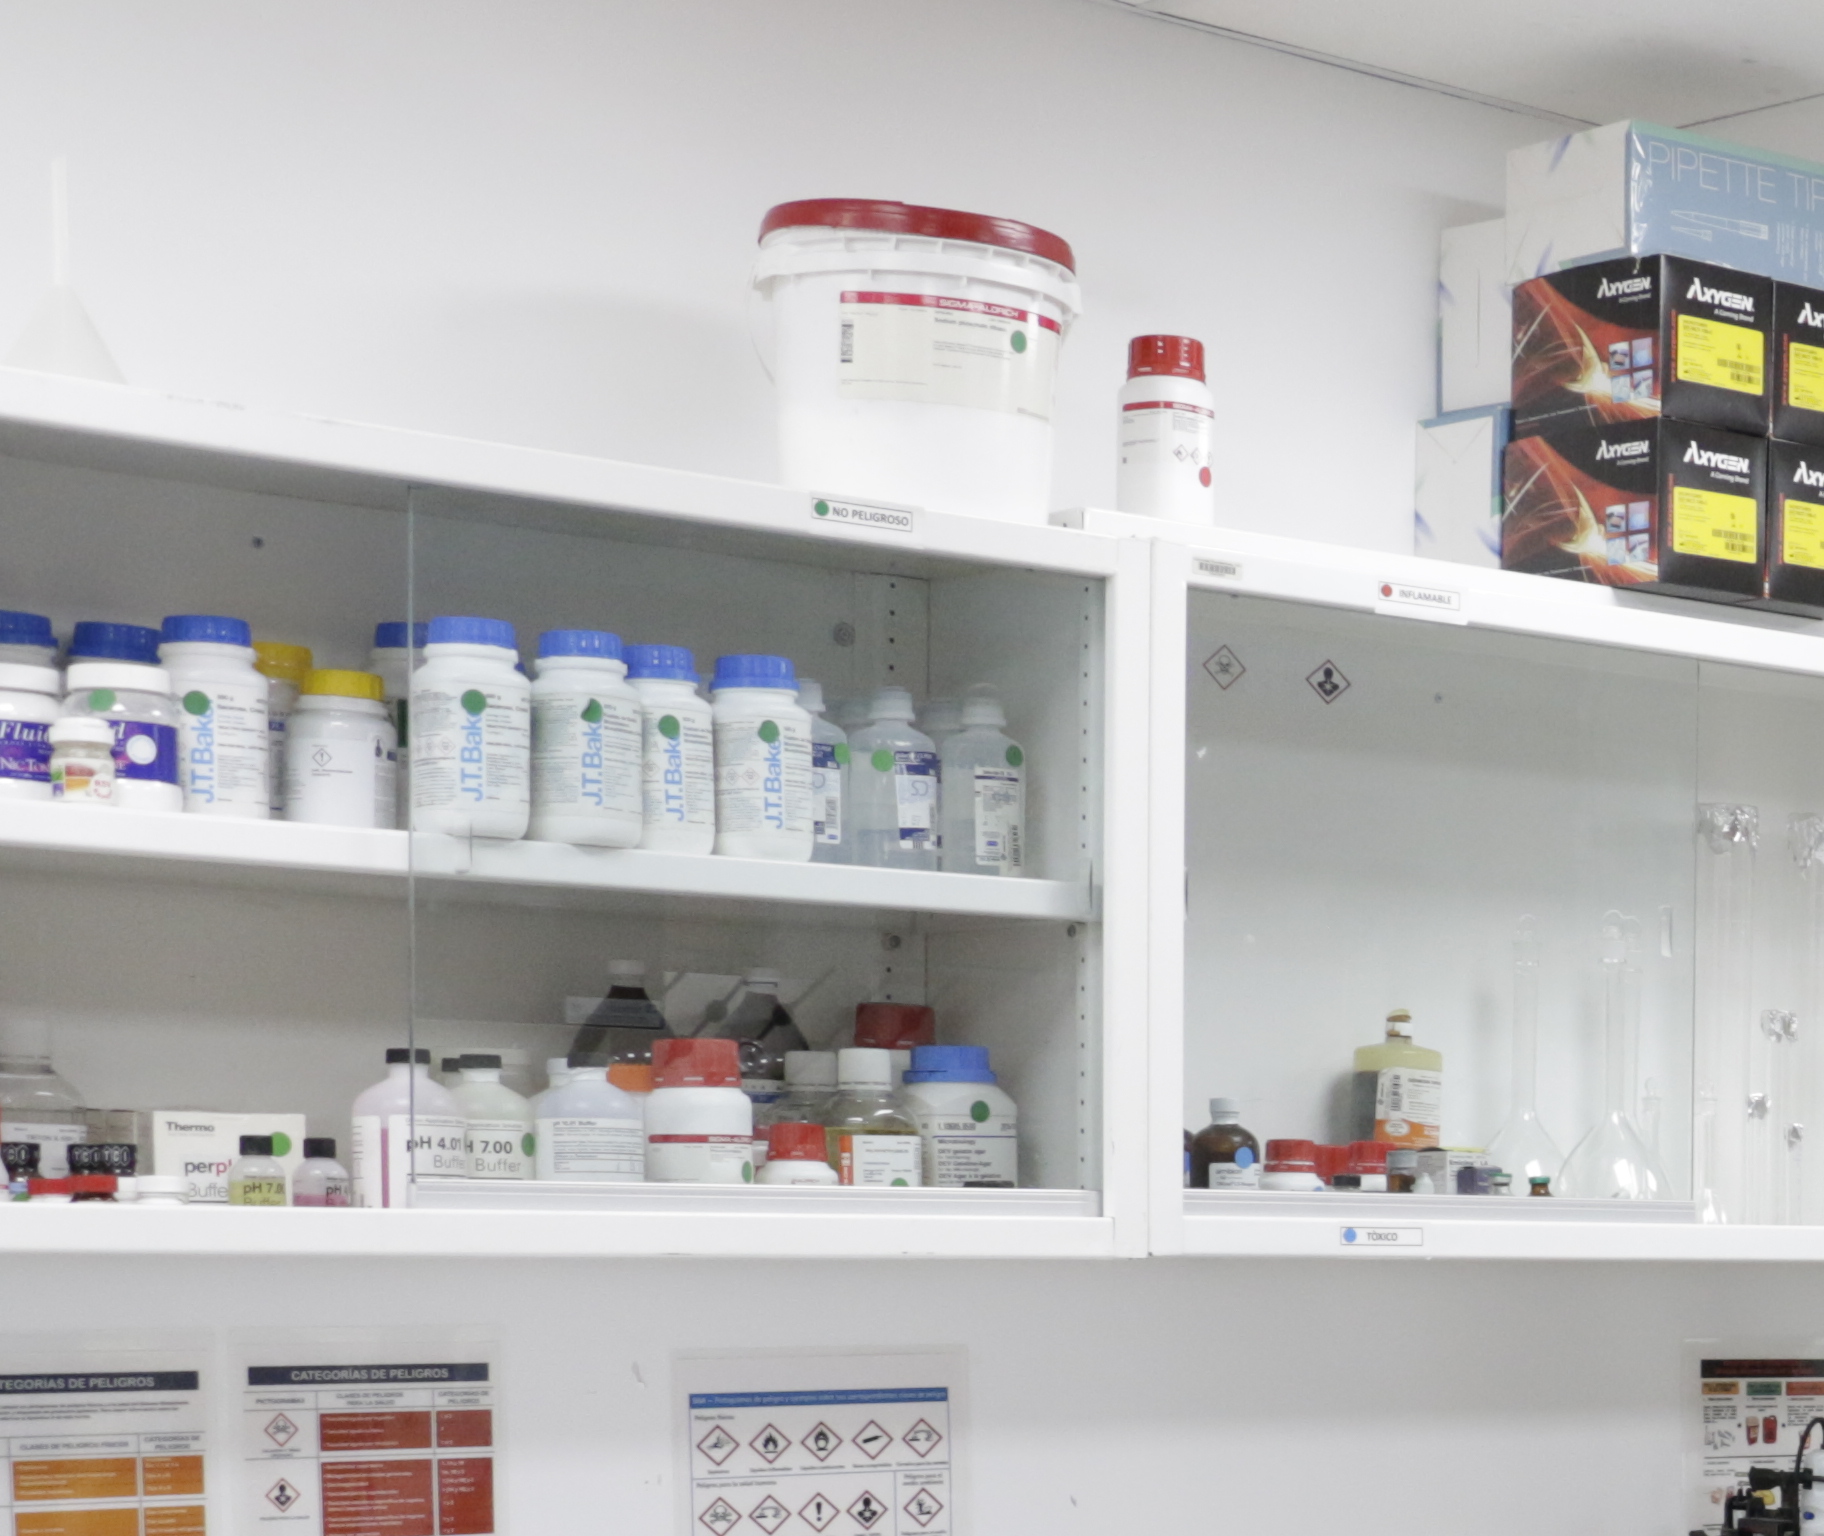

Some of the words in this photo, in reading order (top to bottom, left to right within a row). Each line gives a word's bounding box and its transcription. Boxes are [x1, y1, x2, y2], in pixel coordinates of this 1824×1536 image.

[1649, 141, 1777, 204] PIPETTE
[1597, 276, 1651, 299] AXYGEN
[1686, 277, 1755, 312] AXYGEN
[1595, 439, 1650, 461] AXYGEN
[1683, 440, 1750, 474] AXYGEN
[832, 506, 849, 518] NO
[852, 509, 909, 527] PELIGROSO
[1399, 590, 1452, 605] INFLAMABLE
[763, 740, 784, 830] J.T.Bake
[165, 1121, 215, 1132] Thermo
[406, 1136, 432, 1152] pH
[437, 1137, 462, 1150] 4.01
[480, 1140, 513, 1154] 7.00
[184, 1159, 232, 1177] perp
[475, 1157, 522, 1172] Buffer
[188, 1182, 229, 1199] Buffe
[243, 1182, 262, 1195] pH
[326, 1185, 342, 1196] pH
[291, 1368, 368, 1381] CATEGORÍAS
[371, 1370, 387, 1379] DE
[390, 1368, 449, 1379] PELIGROS
[0, 1376, 66, 1390] TEGORÍAS
[68, 1378, 87, 1389] DE
[89, 1376, 155, 1389] PELIGROS
